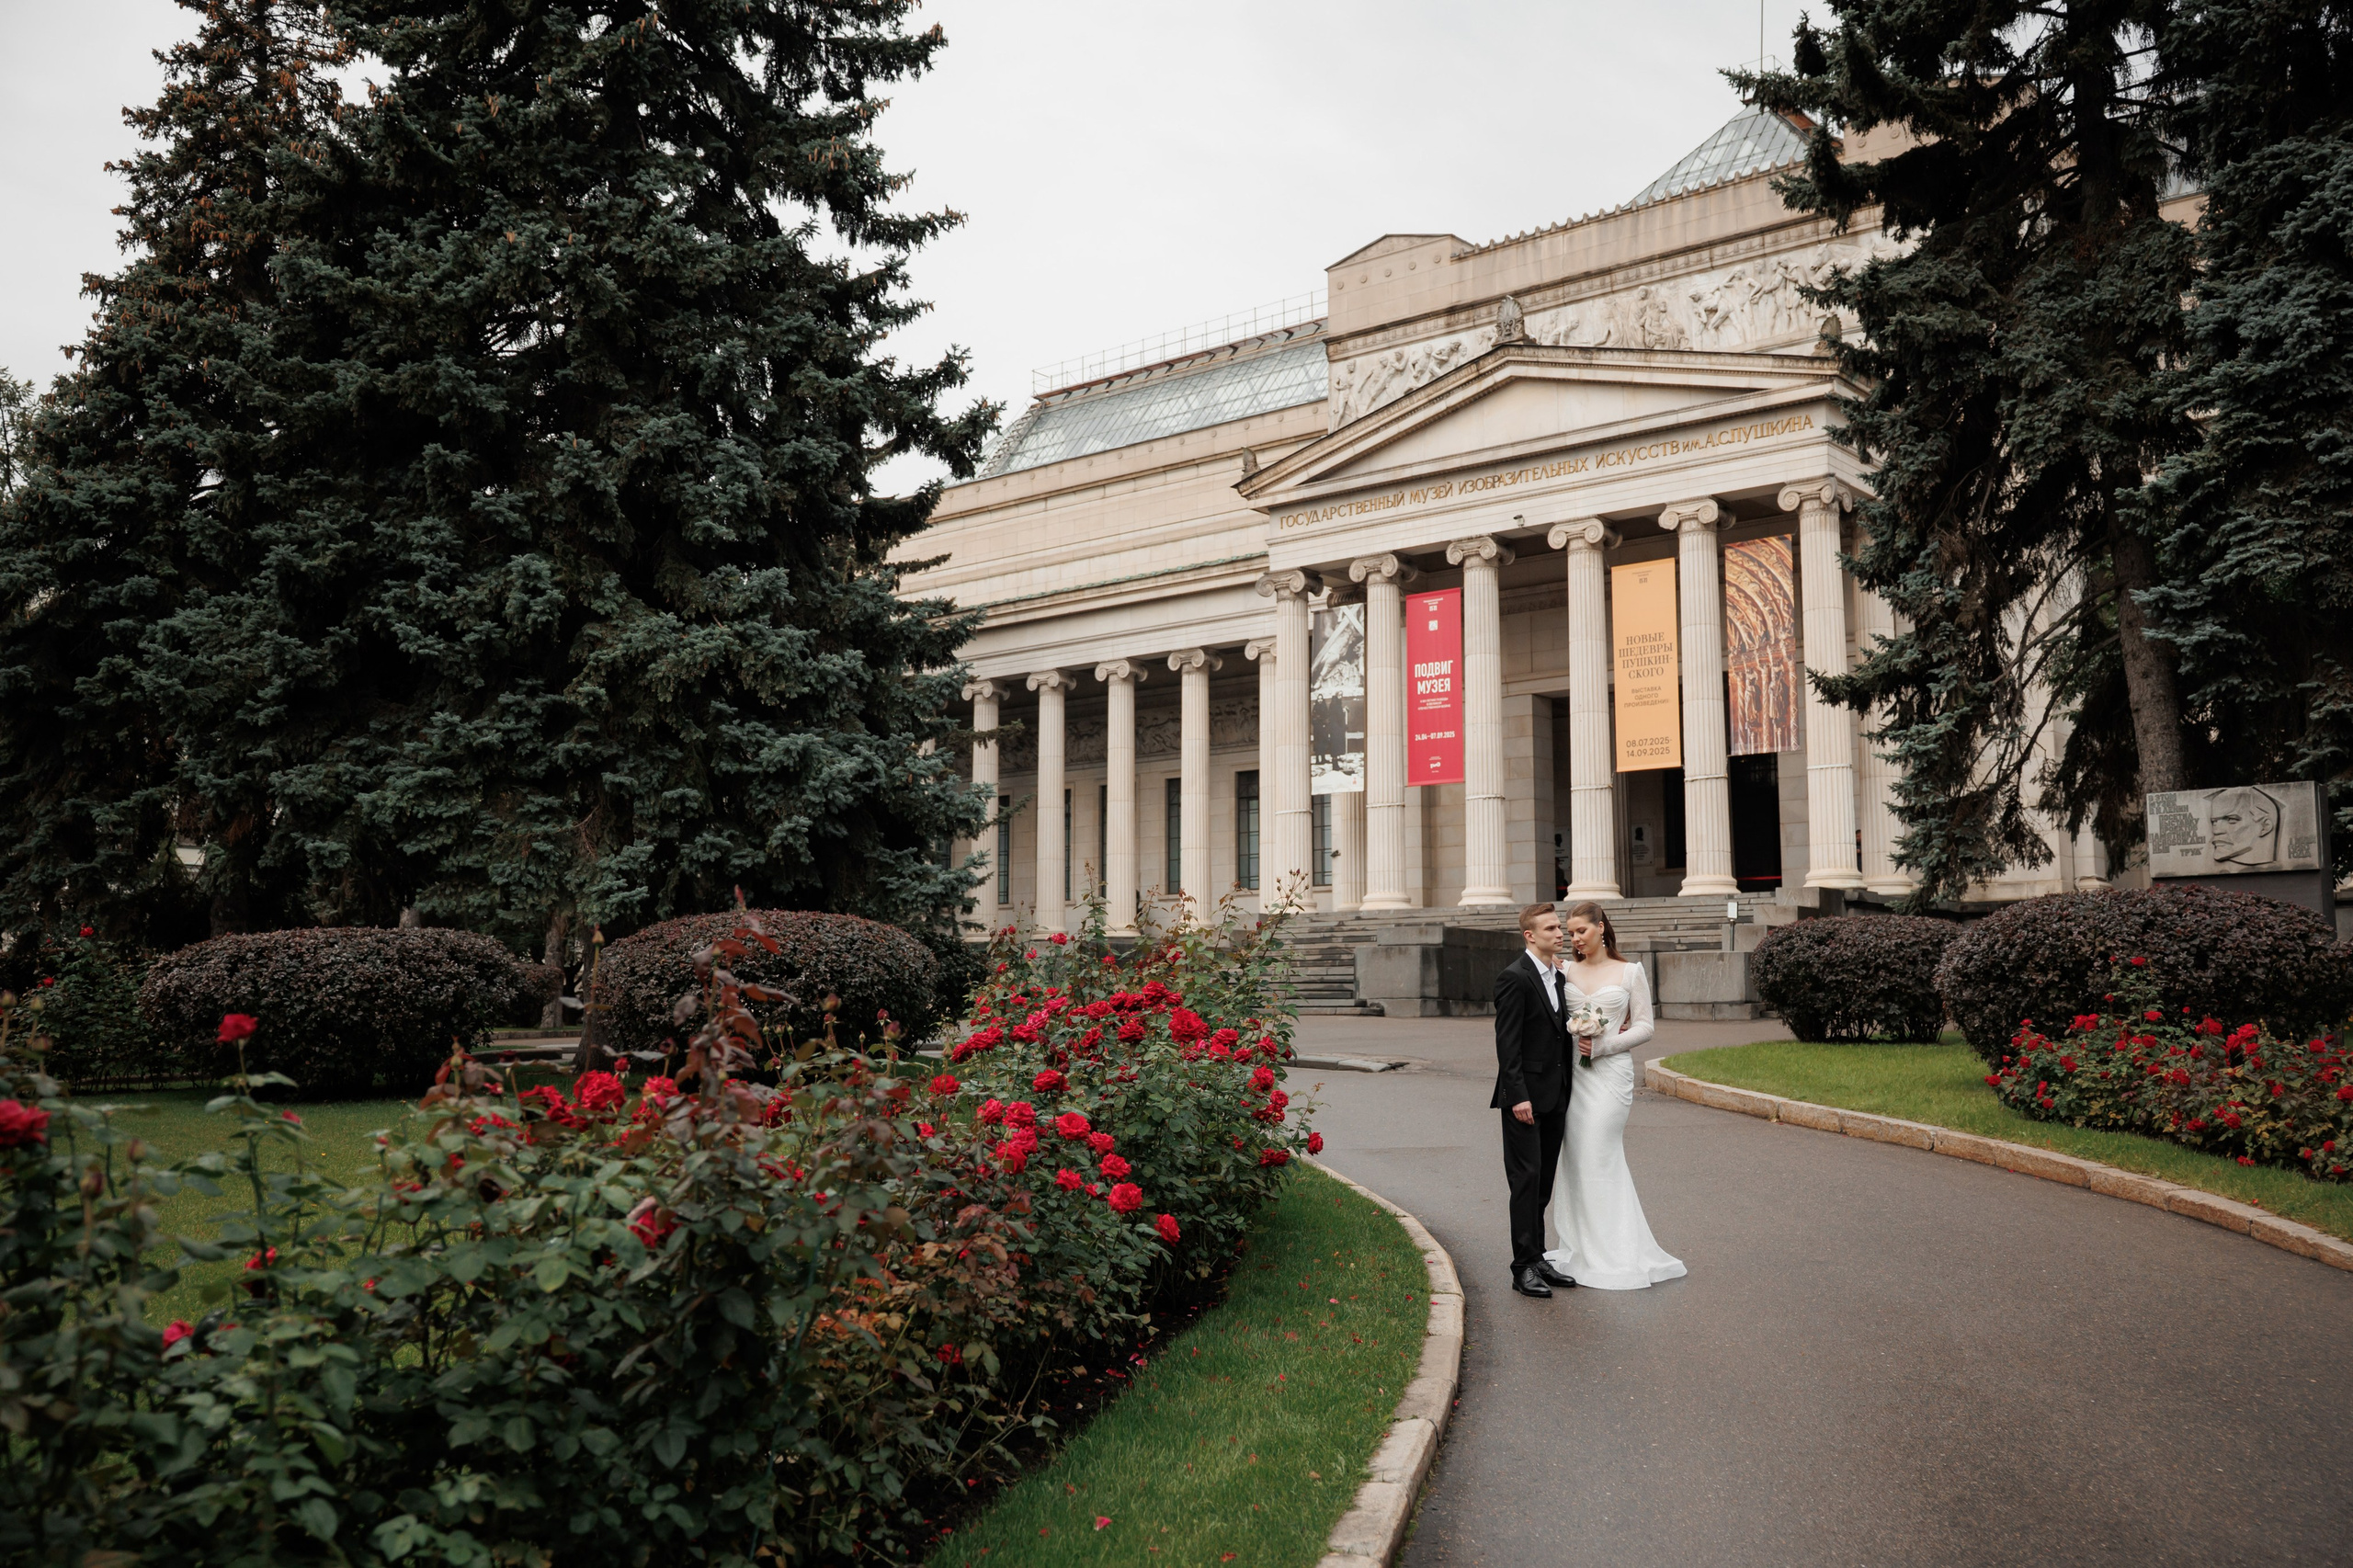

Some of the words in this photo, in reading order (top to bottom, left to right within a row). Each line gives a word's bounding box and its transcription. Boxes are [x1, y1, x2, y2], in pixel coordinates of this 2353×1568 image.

[1279, 490, 1405, 530] ГОСУДАРСТВЕННЫЙ
[1409, 481, 1453, 505] МУЗЕЙ
[1458, 457, 1589, 495] ИЗОБРАЗИТЕЛЬНЫХ
[1595, 439, 1680, 470] ИСКУССТВ
[1626, 631, 1665, 646] НОВЫЕ
[1619, 642, 1673, 658] ШЕДЕВРЫ
[1415, 659, 1454, 678] ПОДВИГ
[1622, 654, 1673, 669] ПУШКИН-
[1628, 666, 1665, 679] СКОГО
[1417, 677, 1451, 695] МУЗЕЯ
[1631, 686, 1662, 694] ВЫСТАВКА
[1634, 692, 1659, 700] ОДНОГО
[1626, 746, 1671, 758] 14.09.2025
